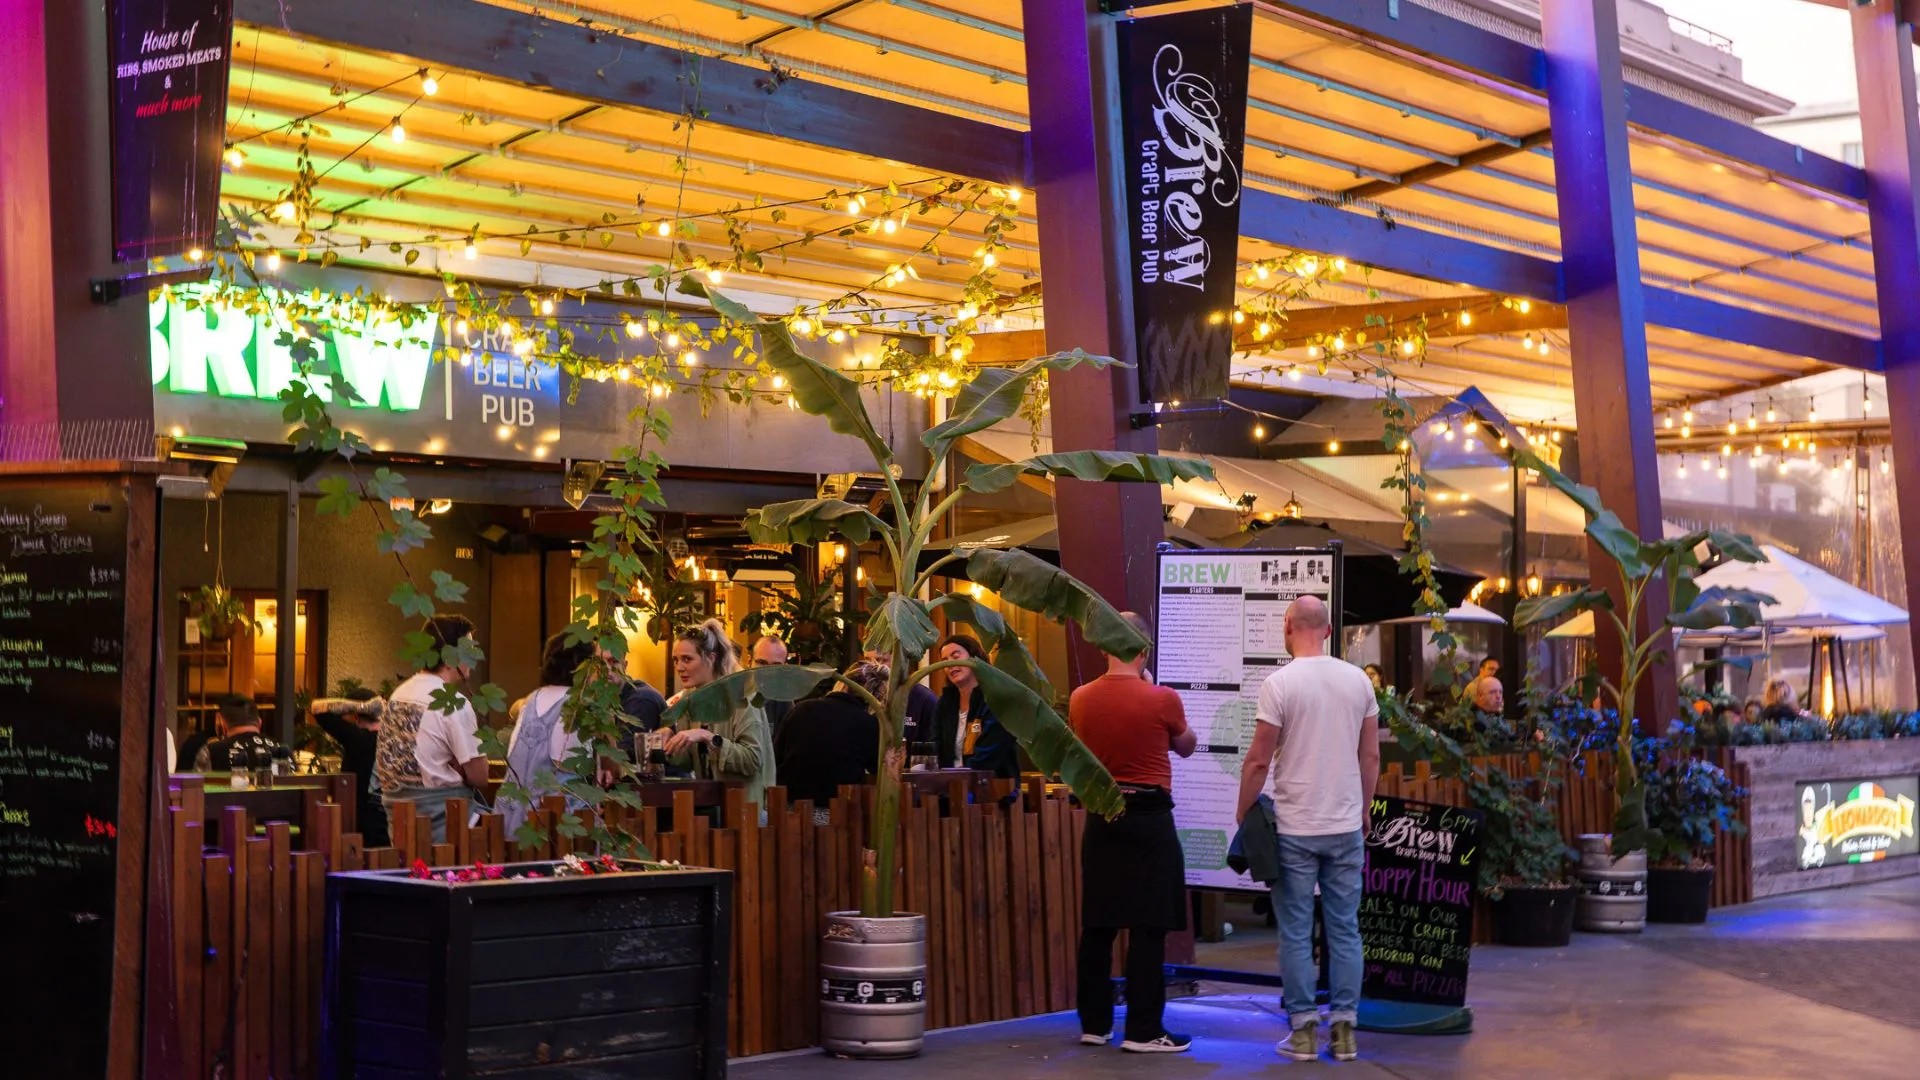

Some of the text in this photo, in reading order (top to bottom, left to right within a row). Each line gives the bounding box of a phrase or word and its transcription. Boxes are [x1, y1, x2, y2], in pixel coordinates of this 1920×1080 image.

[141, 20, 199, 54] House of
[117, 47, 221, 78] RIBS, SMOKED MEATS
[164, 75, 172, 88] &
[136, 92, 202, 118] much more
[1153, 44, 1240, 292] Brew
[1142, 199, 1160, 246] Beer
[474, 356, 541, 391] BEER
[482, 394, 535, 427] PUB
[1164, 563, 1230, 584] BREW
[1190, 683, 1209, 691] PIZZAS
[1364, 815, 1458, 854] Brew
[1418, 860, 1470, 908] HOUR
[1360, 897, 1459, 928] EAL'S ON OUR
[1359, 916, 1459, 944] OCALLY CRAFT
[1362, 944, 1445, 970] ROTORUA GIN
